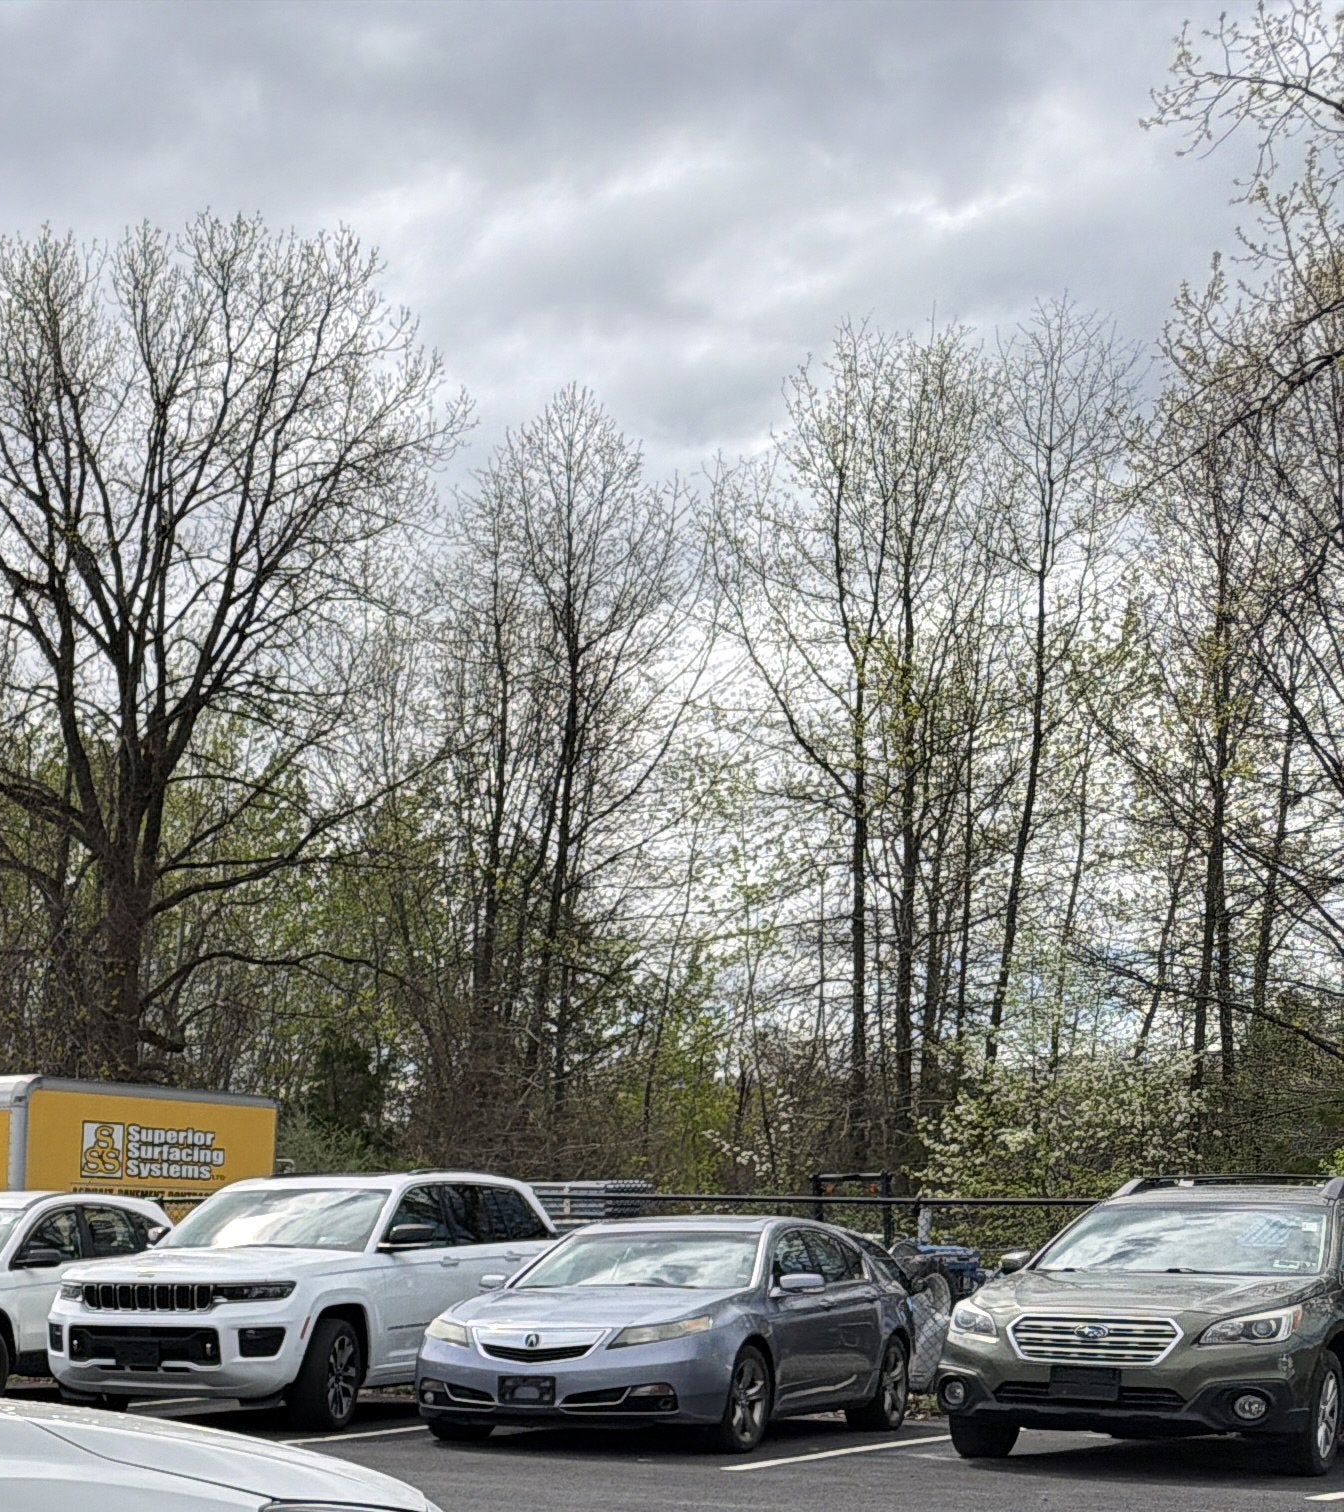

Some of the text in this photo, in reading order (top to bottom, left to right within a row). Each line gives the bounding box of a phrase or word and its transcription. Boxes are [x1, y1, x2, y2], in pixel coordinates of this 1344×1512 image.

[127, 1124, 215, 1145] Superior
[127, 1142, 225, 1166] Surfacing
[127, 1159, 211, 1179] Systems
